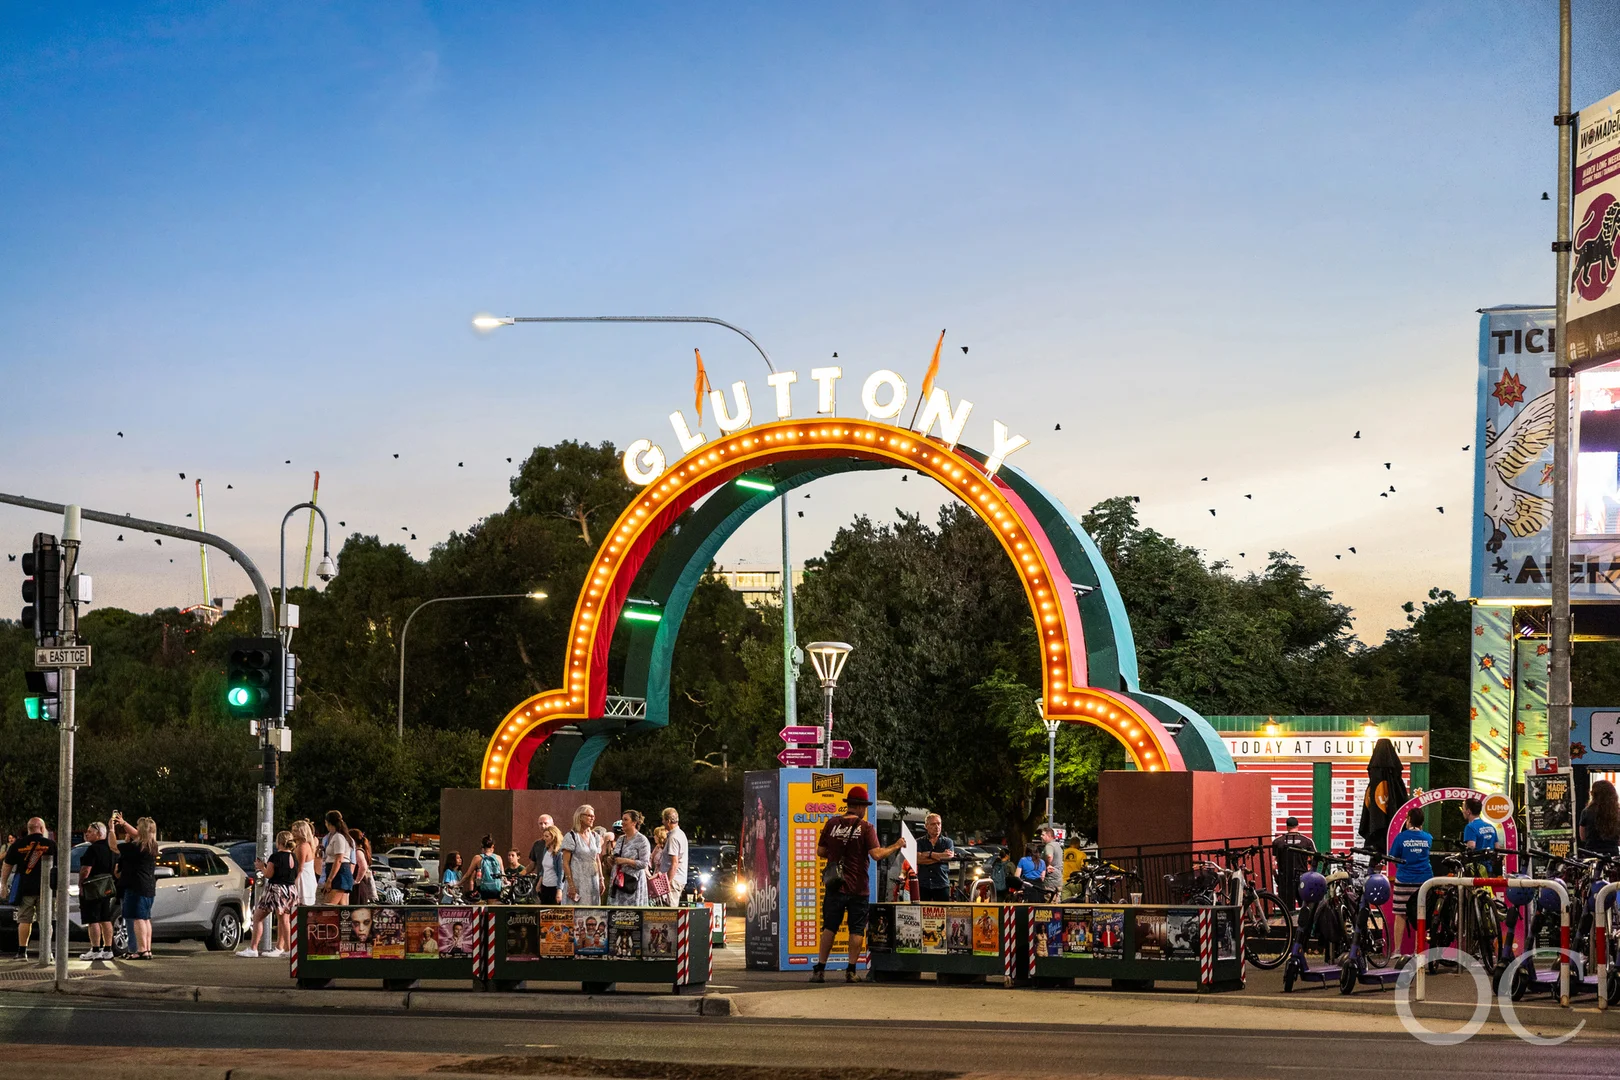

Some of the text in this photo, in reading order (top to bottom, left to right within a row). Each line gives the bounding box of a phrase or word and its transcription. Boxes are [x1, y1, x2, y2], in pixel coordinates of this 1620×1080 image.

[622, 366, 1031, 486] GLUTTONY
[50, 650, 85, 662] EAST TCE
[1231, 741, 1413, 754] TODAY AT GLUTTNY
[1546, 783, 1568, 792] MAGIC
[1419, 789, 1483, 805] INFO BOOTH
[1546, 790, 1565, 800] HUNT
[805, 802, 837, 813] GIGS
[1549, 842, 1570, 852] MAGIC
[307, 923, 339, 940] RED
[340, 942, 367, 952] PARTY GIRL
